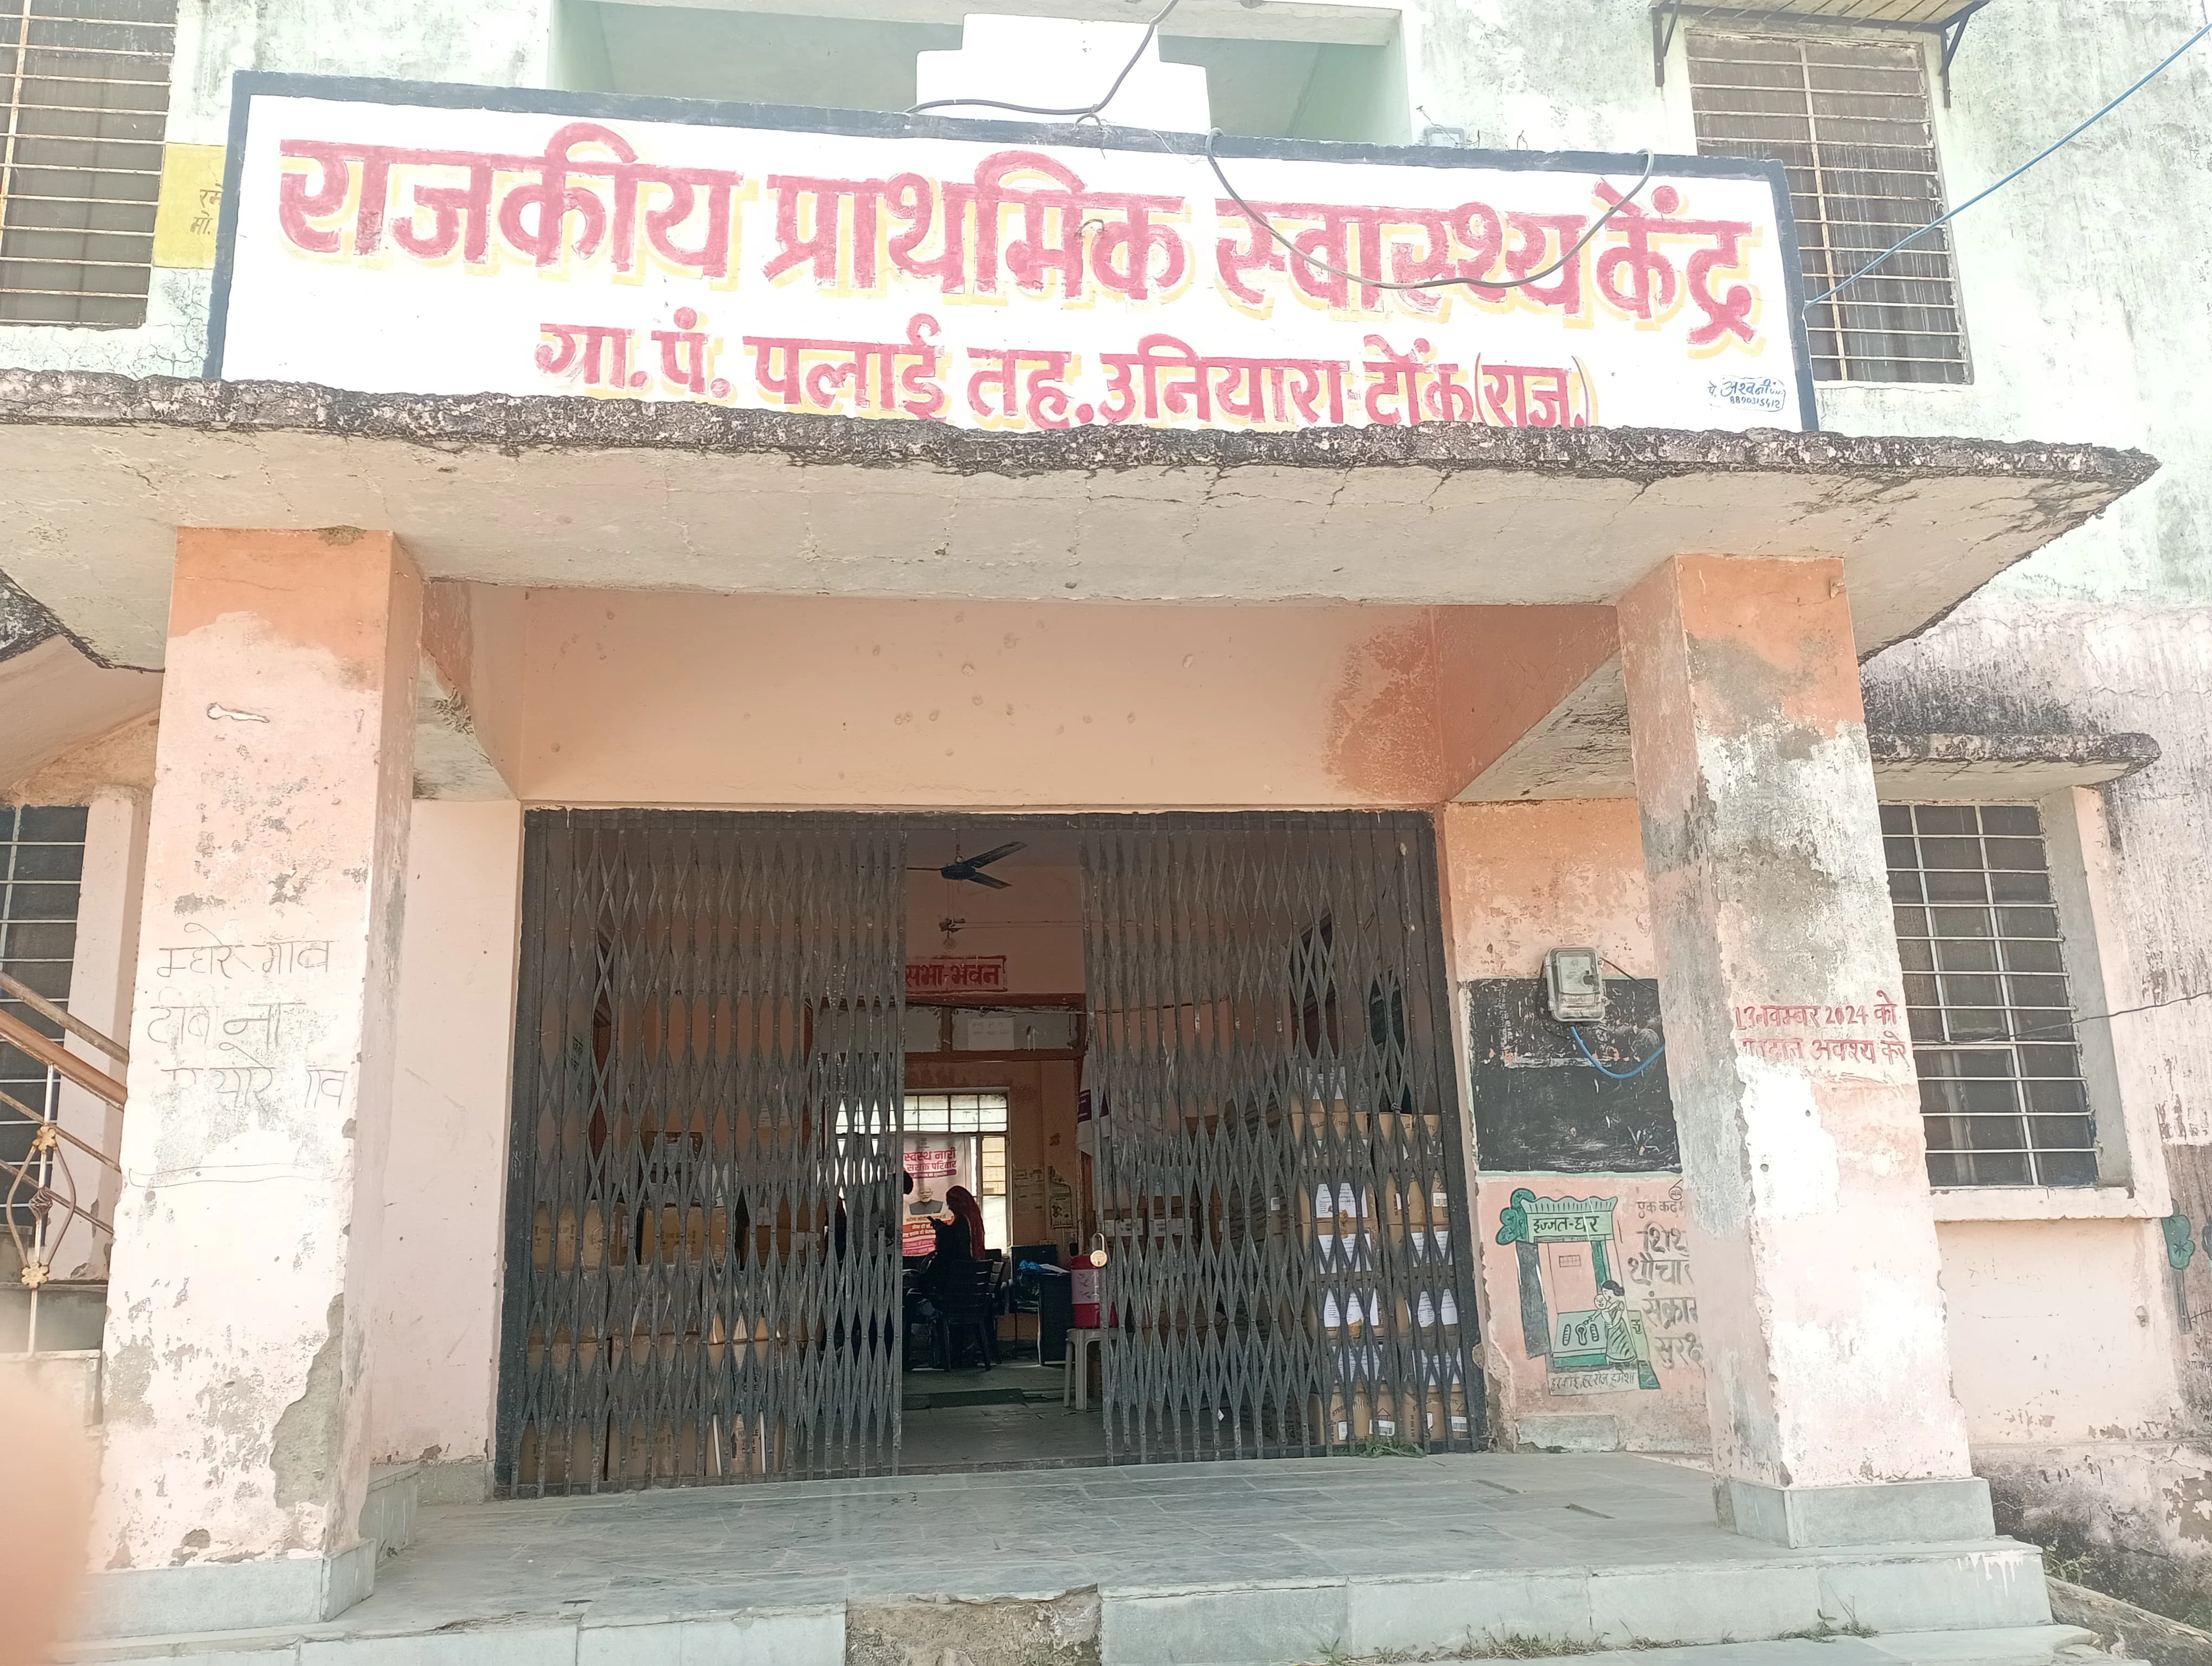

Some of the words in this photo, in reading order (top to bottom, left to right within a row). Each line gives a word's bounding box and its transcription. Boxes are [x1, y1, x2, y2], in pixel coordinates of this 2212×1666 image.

[280, 123, 745, 279] राजकीय
[762, 151, 1186, 300] प्राथमिक
[1214, 198, 1589, 315] स्वास्थ्य
[743, 313, 942, 422] पलाई
[1825, 1005, 1869, 1027] 2024
[1874, 990, 1899, 1026] को
[1811, 1040, 1877, 1064] अवश्य
[933, 1146, 956, 1159] नारी
[931, 1161, 956, 1170] परिवार
[1636, 1201, 1657, 1219] एक
